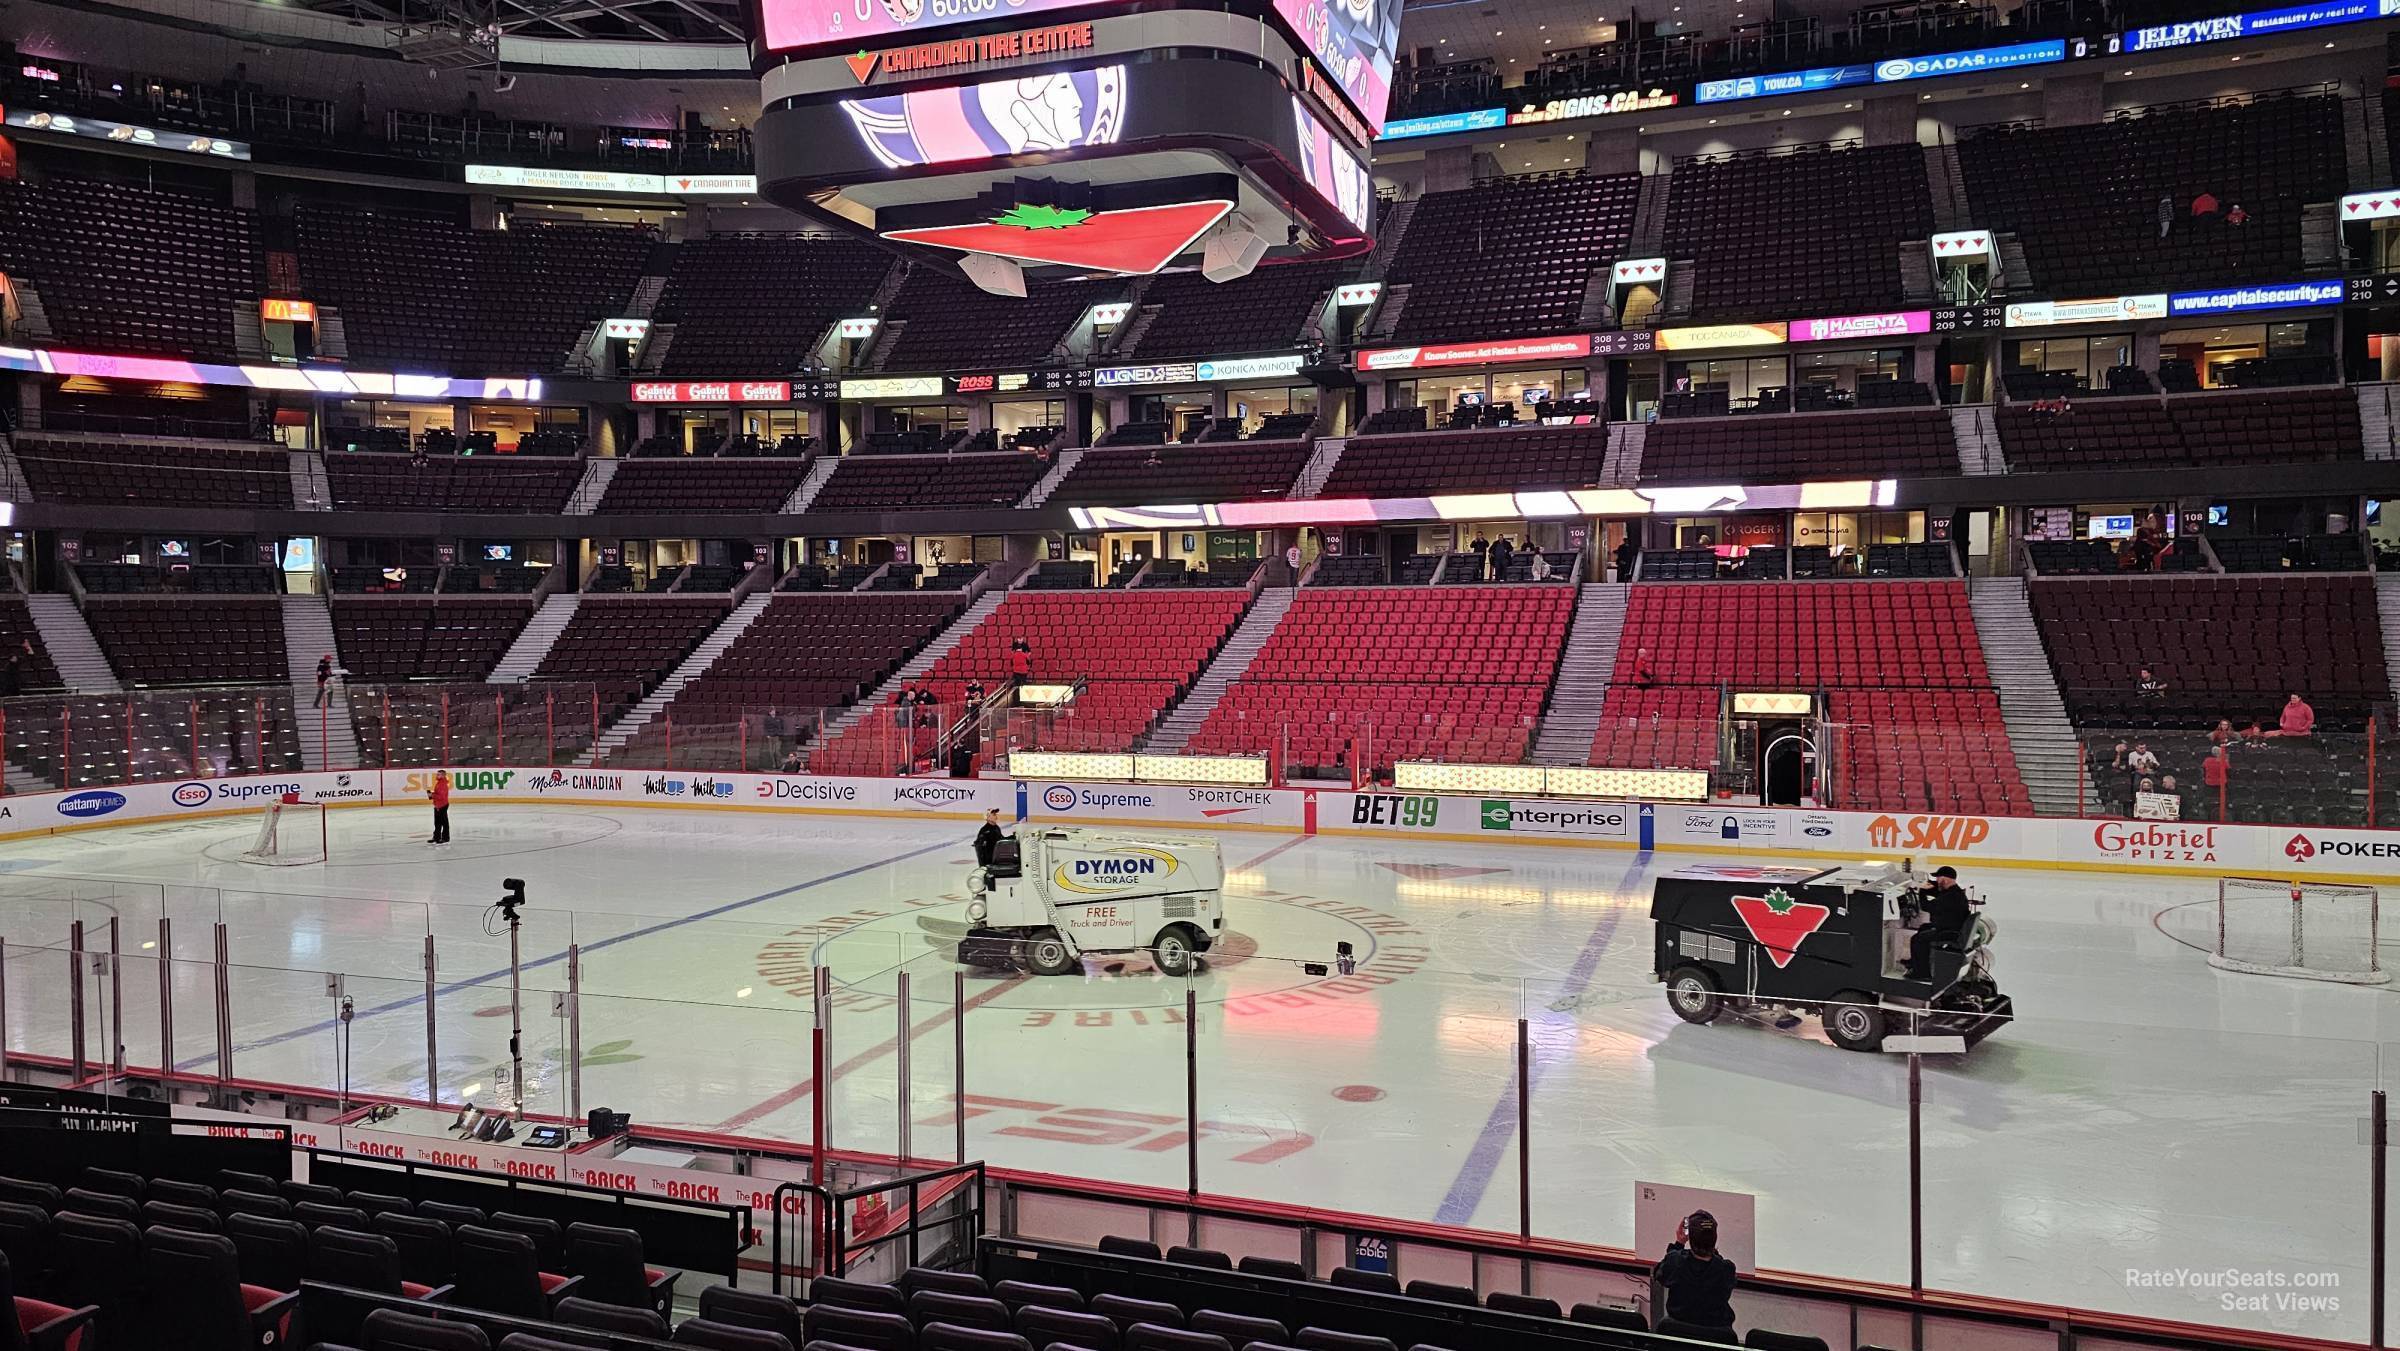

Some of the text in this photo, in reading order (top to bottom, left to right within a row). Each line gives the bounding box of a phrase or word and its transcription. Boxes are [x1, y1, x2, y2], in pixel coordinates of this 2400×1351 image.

[882, 23, 1093, 72] CANADIAN TIRE CENTRE
[2075, 42, 2086, 57] 0
[2109, 39, 2119, 53] 0
[1915, 49, 2061, 73] GADAR PROMOTIONS
[1763, 76, 1802, 91] YOW.CA
[1545, 90, 1639, 121] SIGNS.CA
[523, 170, 547, 178] ROGER
[549, 171, 580, 180] NEILSON
[693, 179, 751, 188] CANADIAN TIRE
[2352, 279, 2372, 289] 310
[2173, 284, 2342, 311] www.capitalsecurity.ca
[2352, 291, 2372, 300] 210
[1936, 311, 1955, 319] 309
[1983, 308, 2000, 317] 310
[1829, 315, 1907, 331] MAGENTA
[1936, 322, 1955, 330] 209
[1983, 319, 2000, 327] 210
[1594, 335, 1612, 343] 308
[1633, 333, 1650, 341] 309
[1594, 345, 1611, 353] 208
[1633, 343, 1650, 351] 209
[1424, 352, 1447, 361] Know
[1217, 361, 1300, 376] KONICA MINOLT
[959, 376, 993, 388] ROSS
[1097, 368, 1153, 384] ALIGNED
[636, 384, 676, 396] Gabriel
[689, 384, 729, 396] Gabriel
[742, 384, 782, 396] Gabriel
[1933, 520, 1950, 528] 107
[2184, 513, 2203, 521] 108
[61, 541, 78, 549] 102
[604, 547, 616, 555] 103
[755, 547, 767, 555] 103
[528, 775, 623, 793] Molson CANADIAN
[777, 780, 856, 800] Decisive
[179, 790, 206, 800] Esso
[219, 782, 301, 801] Supreme
[894, 787, 976, 801] JACKPOTCITY
[1189, 788, 1271, 805] SPORTCHEK
[59, 797, 101, 812] mattamy
[101, 796, 124, 806] HOMES
[1049, 790, 1153, 811] Esso Supreme
[1352, 795, 1439, 827] BET99
[1490, 807, 1623, 828] enterprise
[1686, 816, 1714, 828] Ford
[1903, 816, 1989, 850] SKIP
[2094, 822, 2218, 851] Gabriel
[2131, 849, 2216, 861] PIZZA
[2321, 841, 2400, 857] POKER
[1075, 859, 1155, 875] DYMON
[1093, 876, 1140, 884] STORAGE
[1087, 907, 1117, 918] FREE
[1070, 919, 1134, 928] Truck and Driver
[1021, 1008, 1200, 1029] TIRE
[262, 1130, 317, 1146] The BICK
[346, 1140, 404, 1159] The BRICK
[418, 1149, 479, 1170] The BRICK
[493, 1158, 556, 1180] The BRICK
[571, 1168, 637, 1191] The BRICK
[651, 1179, 720, 1203] The BRICK
[736, 1190, 806, 1215] The BRCK
